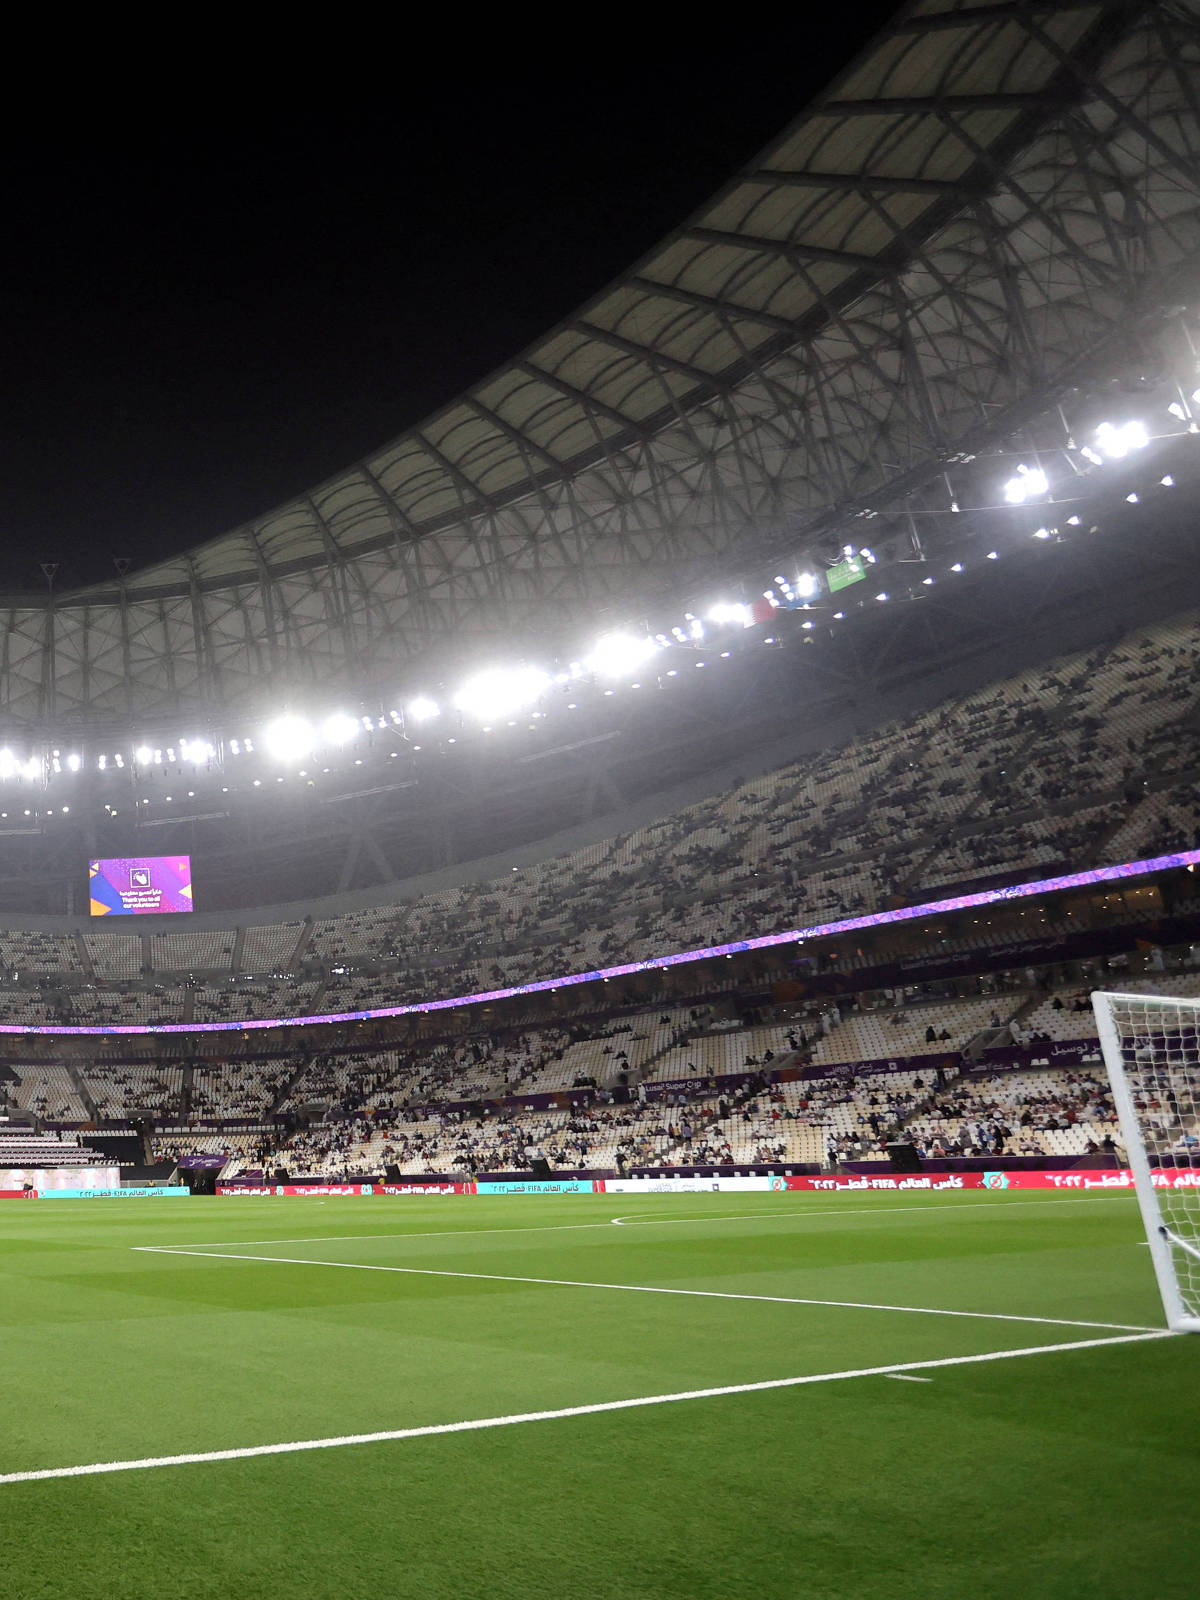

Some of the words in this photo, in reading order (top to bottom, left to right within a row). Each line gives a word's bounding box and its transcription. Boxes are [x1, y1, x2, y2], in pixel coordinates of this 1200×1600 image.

[645, 1082, 665, 1092] Lusail
[666, 1081, 687, 1091] Super
[687, 1080, 702, 1089] Cup
[899, 1178, 931, 1190] العالم
[932, 1175, 963, 1190] كأس
